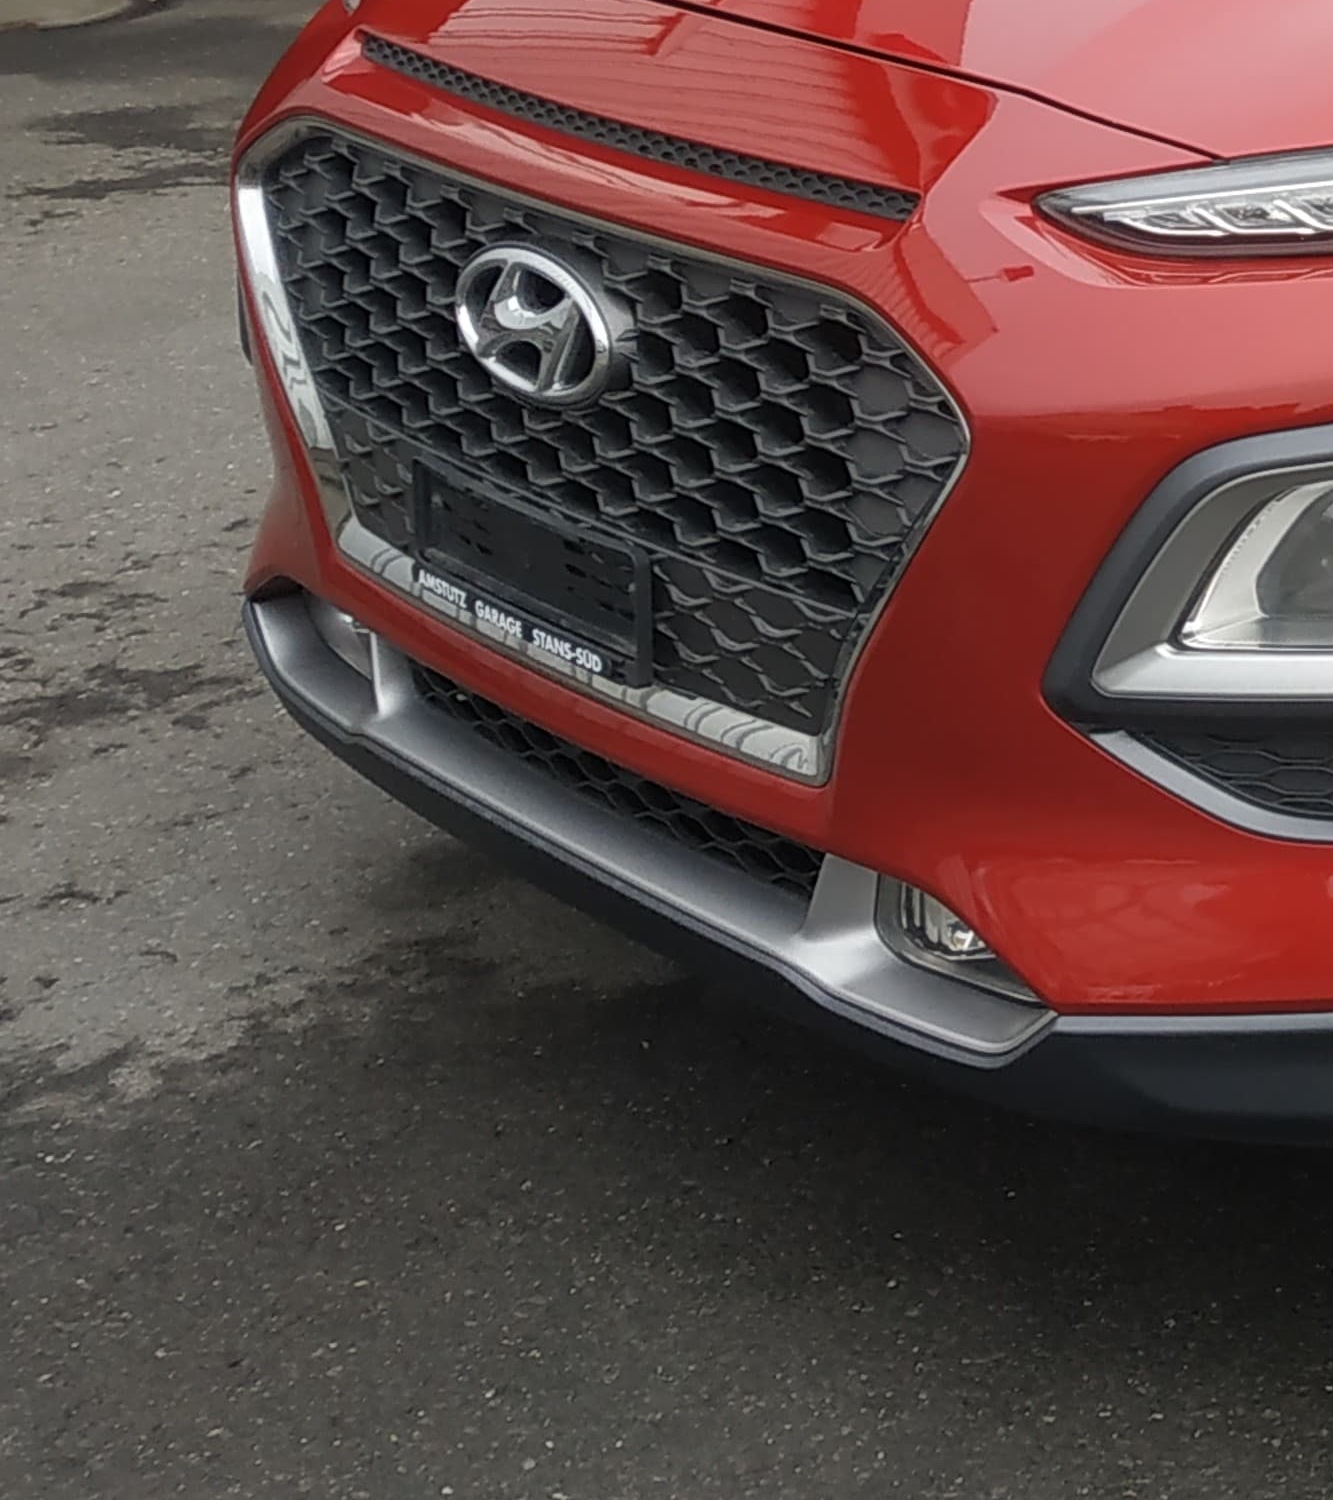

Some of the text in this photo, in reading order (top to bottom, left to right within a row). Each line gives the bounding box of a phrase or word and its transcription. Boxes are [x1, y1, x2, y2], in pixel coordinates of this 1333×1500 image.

[418, 569, 602, 673] AMSTUTZ GARAGE STANS-SÜD
